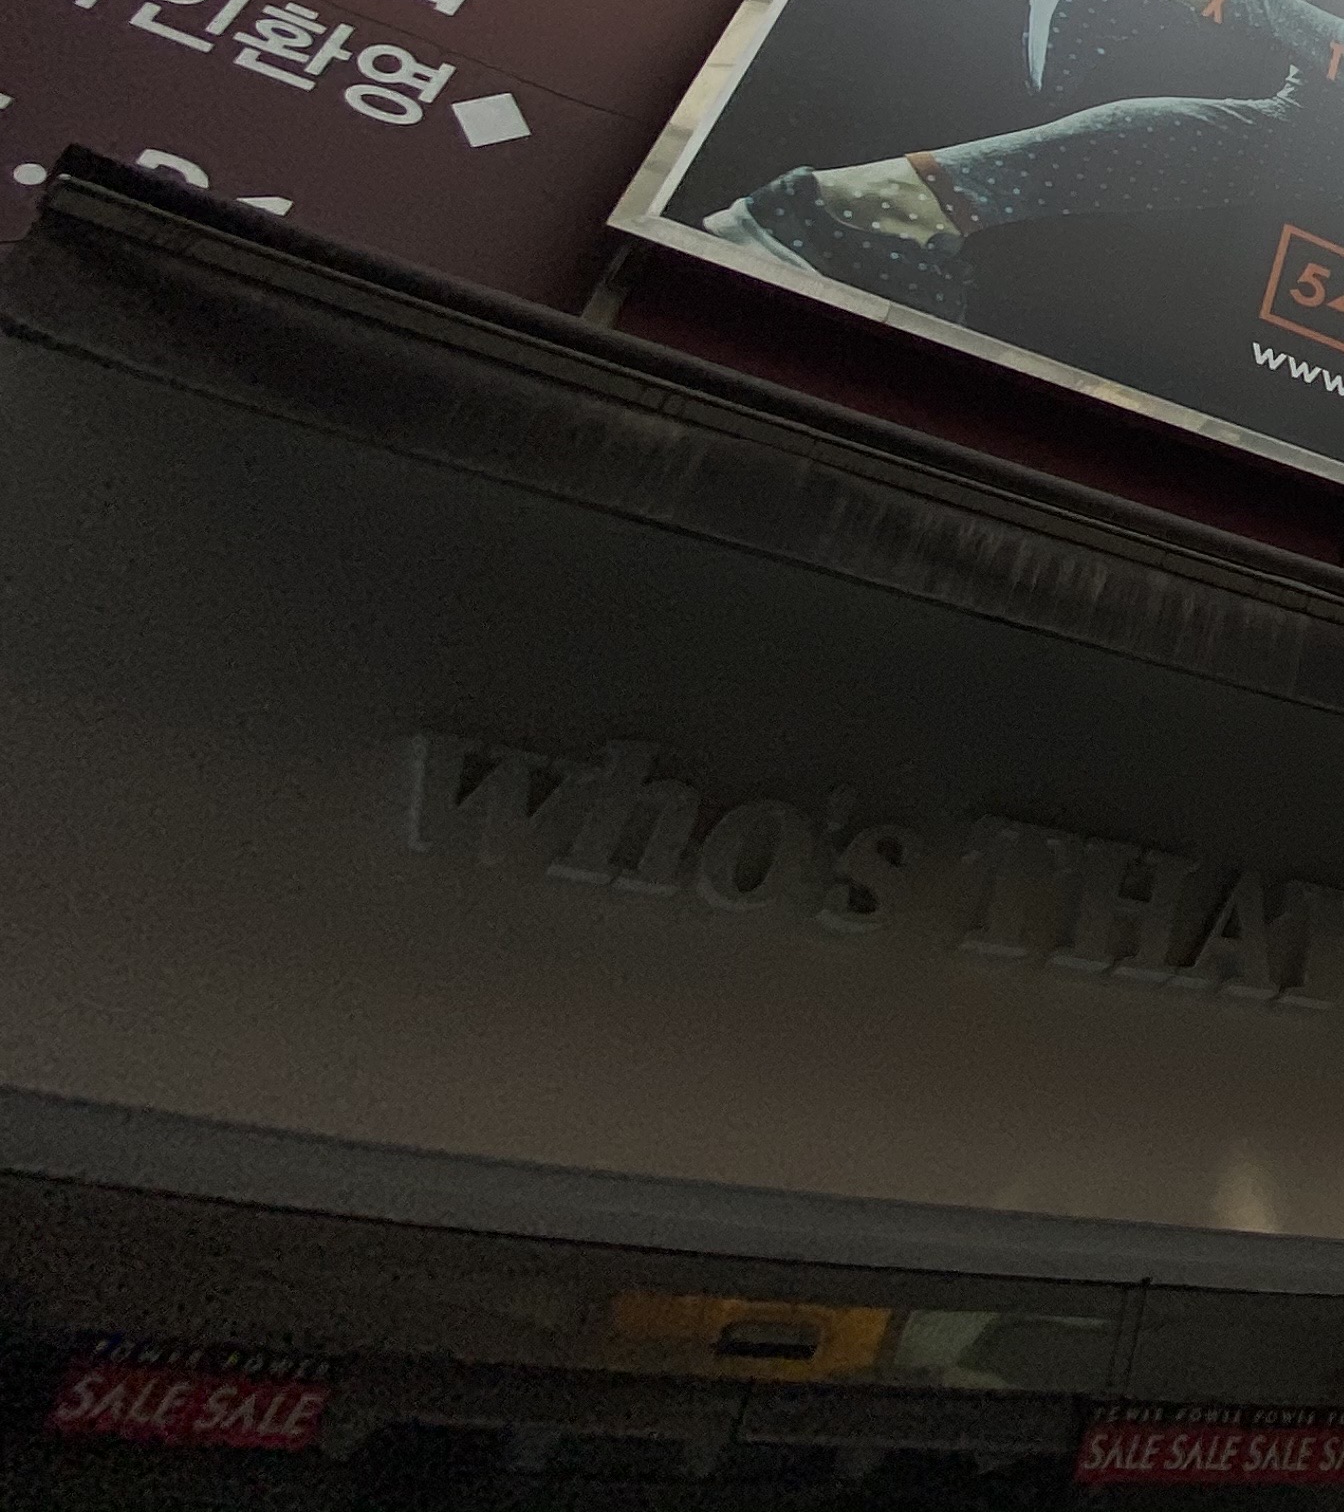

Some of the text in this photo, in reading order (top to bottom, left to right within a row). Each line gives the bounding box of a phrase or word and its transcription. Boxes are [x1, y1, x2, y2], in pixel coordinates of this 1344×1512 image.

[55, 1372, 331, 1438] SALE SALE
[1083, 1433, 1163, 1470] SALE
[1164, 1434, 1241, 1471] SALE
[1242, 1435, 1317, 1472] SALE
